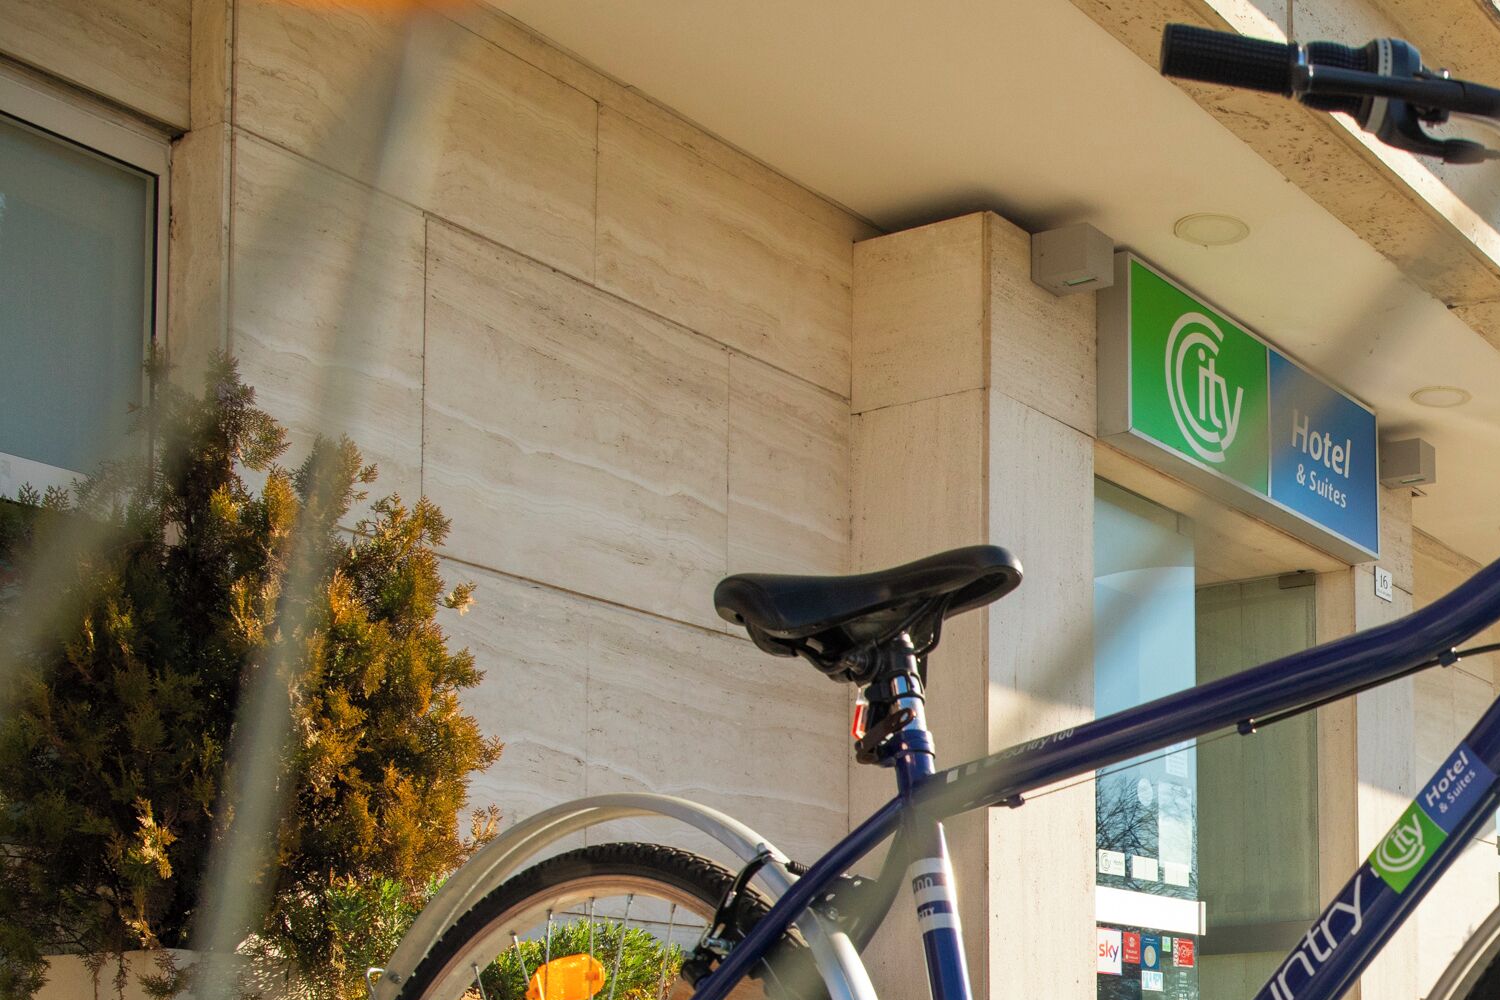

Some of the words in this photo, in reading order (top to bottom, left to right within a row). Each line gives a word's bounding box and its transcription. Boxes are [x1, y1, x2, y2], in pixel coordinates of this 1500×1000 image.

[1165, 312, 1244, 463] City
[1292, 409, 1351, 478] Hotel
[1296, 463, 1306, 486] &
[1309, 471, 1346, 508] Suites
[1380, 573, 1388, 590] 16
[1425, 750, 1469, 807] Hotel
[1438, 802, 1449, 814] &
[1447, 769, 1476, 804] Suites
[1376, 813, 1425, 872] City
[1099, 940, 1119, 962] sky
